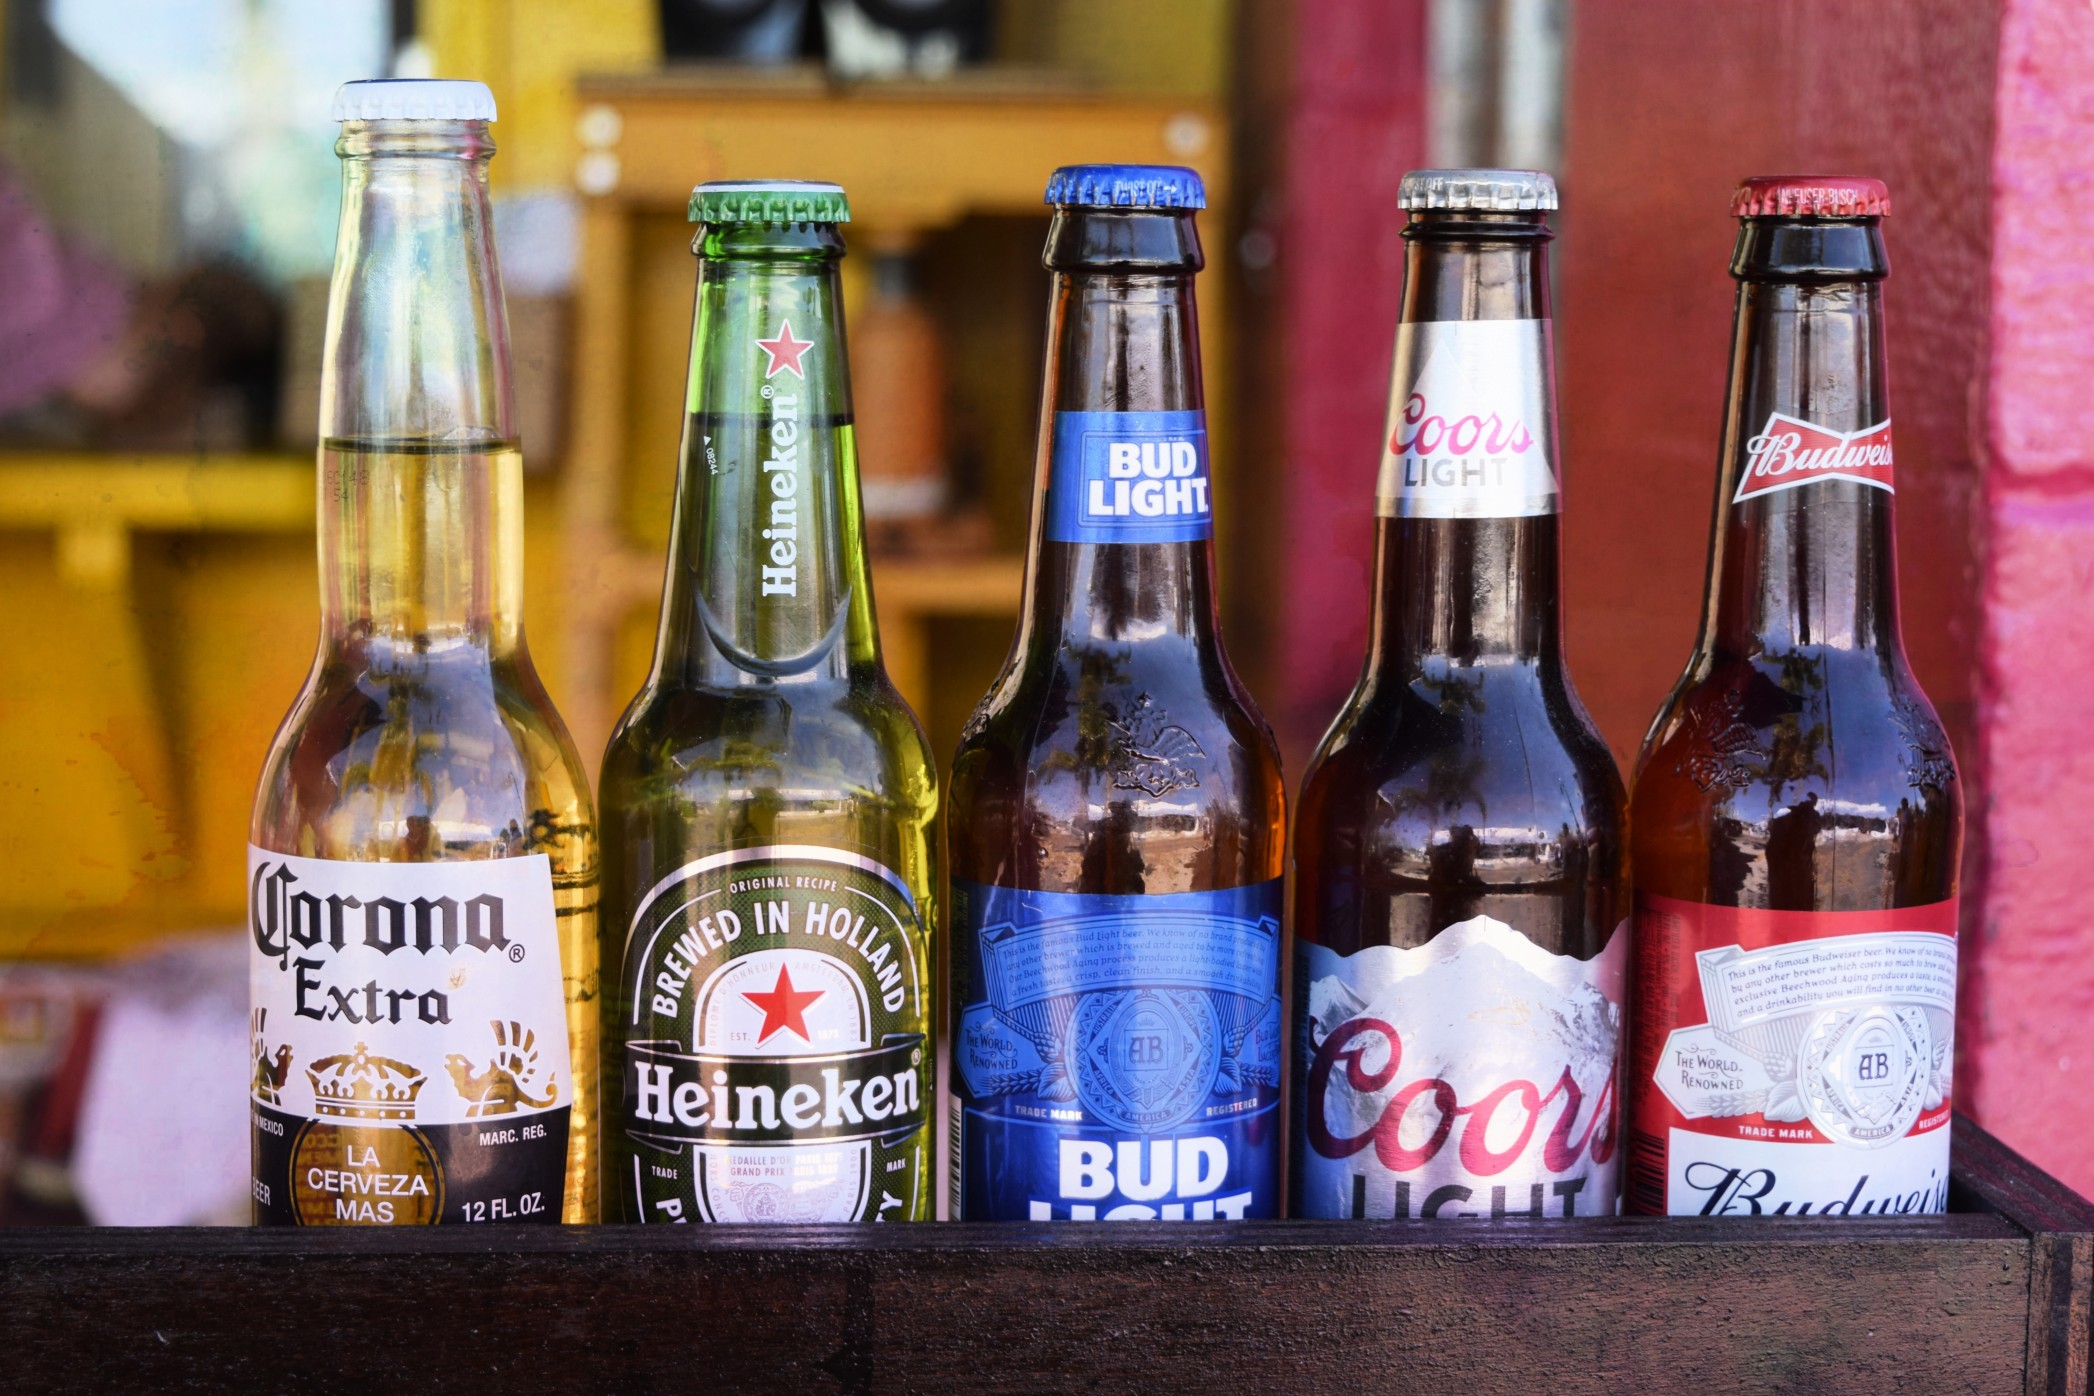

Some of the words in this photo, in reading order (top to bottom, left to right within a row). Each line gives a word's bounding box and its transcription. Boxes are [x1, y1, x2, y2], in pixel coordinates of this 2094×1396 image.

[1389, 392, 1534, 456] Coors
[706, 447, 719, 475] 08244
[1109, 441, 1197, 479] BUD
[1404, 458, 1508, 488] LIGHT
[762, 393, 799, 598] Heineken
[1088, 477, 1207, 517] LIGHT
[729, 876, 790, 894] ORIGINAL
[796, 876, 837, 892] RECIPE
[252, 861, 512, 971] Corona
[1003, 948, 1017, 960] This
[1020, 946, 1025, 954] is
[1027, 941, 1040, 951] the
[1041, 937, 1074, 949] famous
[1076, 931, 1094, 942] Bud
[1097, 930, 1120, 942] Light
[1147, 929, 1159, 937] We
[1162, 927, 1185, 937] know
[1187, 928, 1197, 938] of
[1199, 930, 1209, 939] no
[1210, 931, 1232, 942] brand
[1022, 955, 1041, 967] other
[1044, 948, 1074, 960] brewer
[1076, 944, 1104, 956] which
[1107, 942, 1115, 951] is
[1117, 940, 1151, 951] brewed
[1153, 940, 1171, 949] and
[1196, 943, 1205, 951] to
[1206, 943, 1216, 952] be
[652, 909, 742, 1018] BREWED
[754, 901, 790, 935] IN
[805, 901, 905, 1013] HOLLAND
[1008, 974, 1022, 984] Our
[1023, 959, 1070, 978] Beechwood
[1072, 957, 1099, 969] Aging
[1101, 953, 1136, 966] process
[1139, 953, 1179, 965] produces
[1728, 970, 1747, 982] This
[1748, 967, 1756, 976] is
[1757, 963, 1772, 973] the
[1774, 956, 1809, 969] famous
[1812, 949, 1861, 963] Budweiser
[1885, 947, 1896, 955] We
[1898, 946, 1915, 955] know
[292, 956, 452, 1025] Extra
[1011, 989, 1017, 997] a
[1017, 982, 1038, 994] fresh
[1104, 966, 1130, 977] clean
[1165, 966, 1184, 975] and
[1193, 968, 1224, 980] smooth
[1731, 984, 1743, 994] by
[1745, 980, 1762, 990] any
[1765, 972, 1790, 984] other
[1793, 966, 1826, 978] brewer
[1830, 961, 1857, 972] which
[1859, 960, 1882, 969] costs
[1895, 959, 1914, 968] much
[1916, 959, 1922, 967] to
[1734, 988, 1777, 1005] exclusive
[1781, 976, 1837, 993] Beechwood
[1841, 973, 1868, 984] Aging
[1871, 971, 1908, 982] produces
[1737, 1005, 1754, 1018] and
[1765, 992, 1823, 1010] drinkability
[1826, 989, 1844, 999] you
[1846, 984, 1863, 995] will
[1864, 983, 1882, 994] find
[1884, 984, 1893, 992] in
[1894, 984, 1904, 992] no
[1905, 984, 1922, 993] other
[730, 1032, 750, 1041] EST.
[966, 1028, 979, 1048] THE
[1129, 1035, 1163, 1064] AB
[970, 1048, 1018, 1070] RENOWNED
[1675, 1051, 1694, 1069] THE
[1858, 1052, 1889, 1081] AB
[1681, 1070, 1743, 1090] RENOWNED
[634, 1060, 920, 1130] Heineken
[1206, 1098, 1258, 1116] REGISTERED
[1306, 1017, 1618, 1177] Coors
[259, 1115, 283, 1137] MEXICO
[1015, 1105, 1047, 1118] TRADE
[1050, 1109, 1083, 1121] MARK
[1125, 1111, 1167, 1121] AMERICA
[479, 1129, 518, 1147] MARC.
[522, 1124, 547, 1141] REG.
[1738, 1125, 1775, 1138] TRADE
[1779, 1129, 1813, 1139] MARK
[1854, 1125, 1891, 1138] AMERICA
[347, 1145, 380, 1168] LA
[886, 1158, 906, 1173] MARK
[1059, 1136, 1228, 1201] BUD
[307, 1167, 429, 1196] CERVEZA
[651, 1165, 678, 1180] TRADE
[731, 1167, 761, 1177] GRAND
[765, 1167, 785, 1177] PRIX
[336, 1198, 394, 1223] MAS
[461, 1201, 485, 1222] 12
[491, 1198, 517, 1220] FL.
[520, 1192, 545, 1215] OZ.
